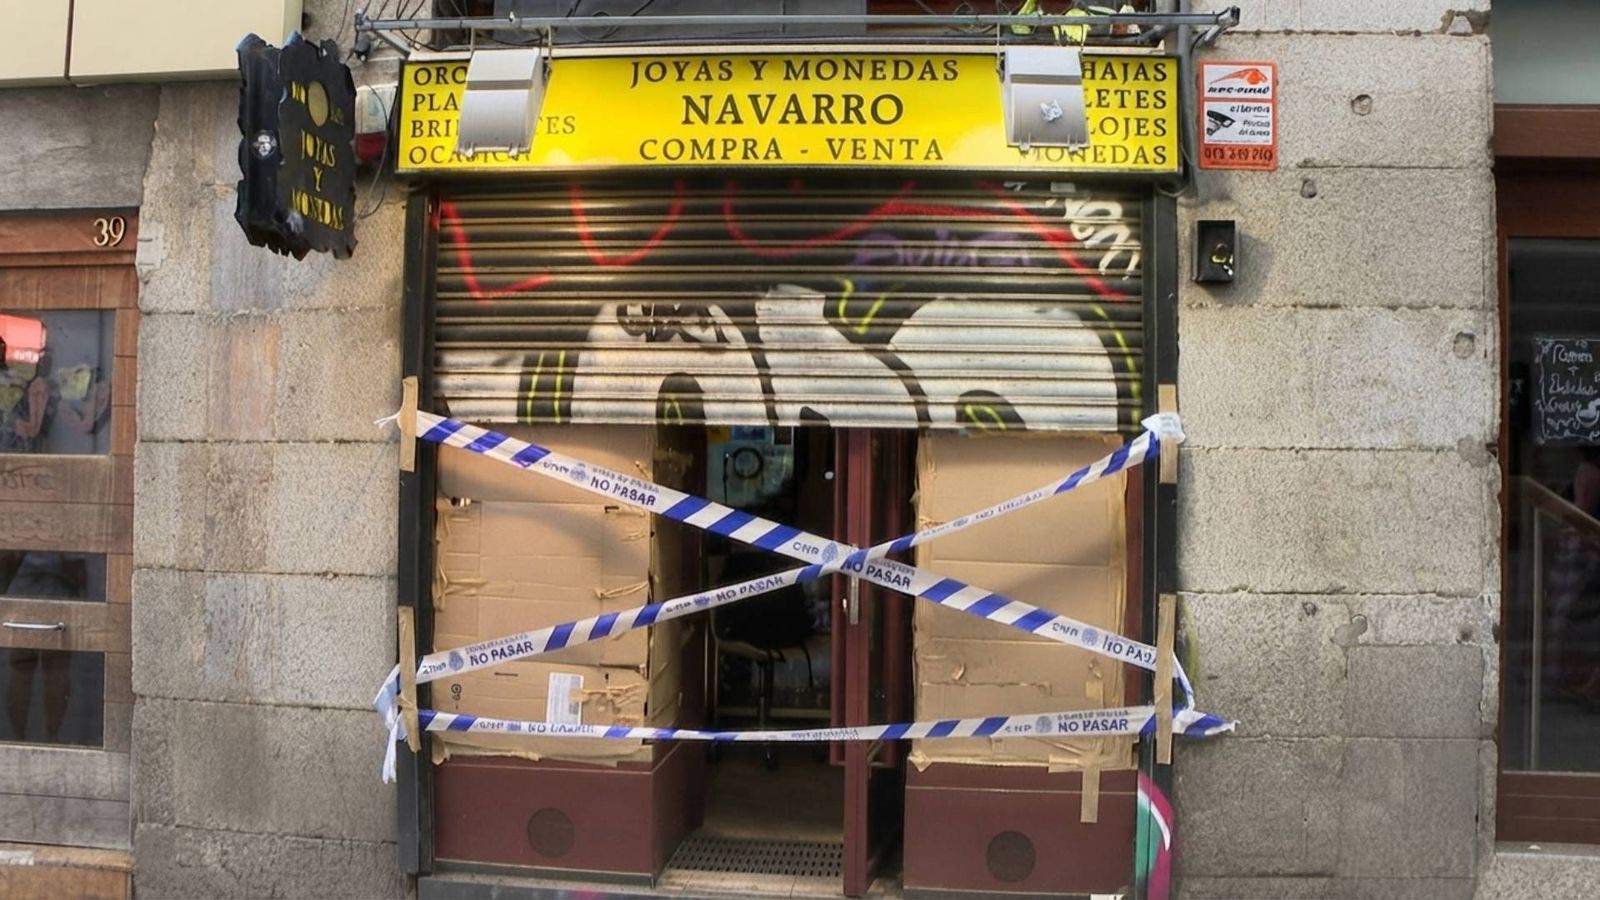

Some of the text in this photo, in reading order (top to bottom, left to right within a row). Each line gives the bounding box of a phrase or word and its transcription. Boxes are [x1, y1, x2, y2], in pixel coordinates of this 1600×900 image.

[630, 59, 959, 88] JOYAS Y MONEDAS
[1081, 61, 1167, 84] HAJAS
[412, 93, 460, 112] PLA
[681, 94, 904, 125] NAVARRO
[1086, 116, 1167, 141] OJES
[639, 138, 783, 161] COMPRA
[826, 139, 943, 161] VENTA
[313, 165, 322, 192] Y
[93, 216, 126, 247] 39
[866, 565, 912, 589] PASAR
[469, 653, 489, 667] NO
[490, 640, 534, 662] PASAR
[1057, 718, 1129, 733] NO PASAR
